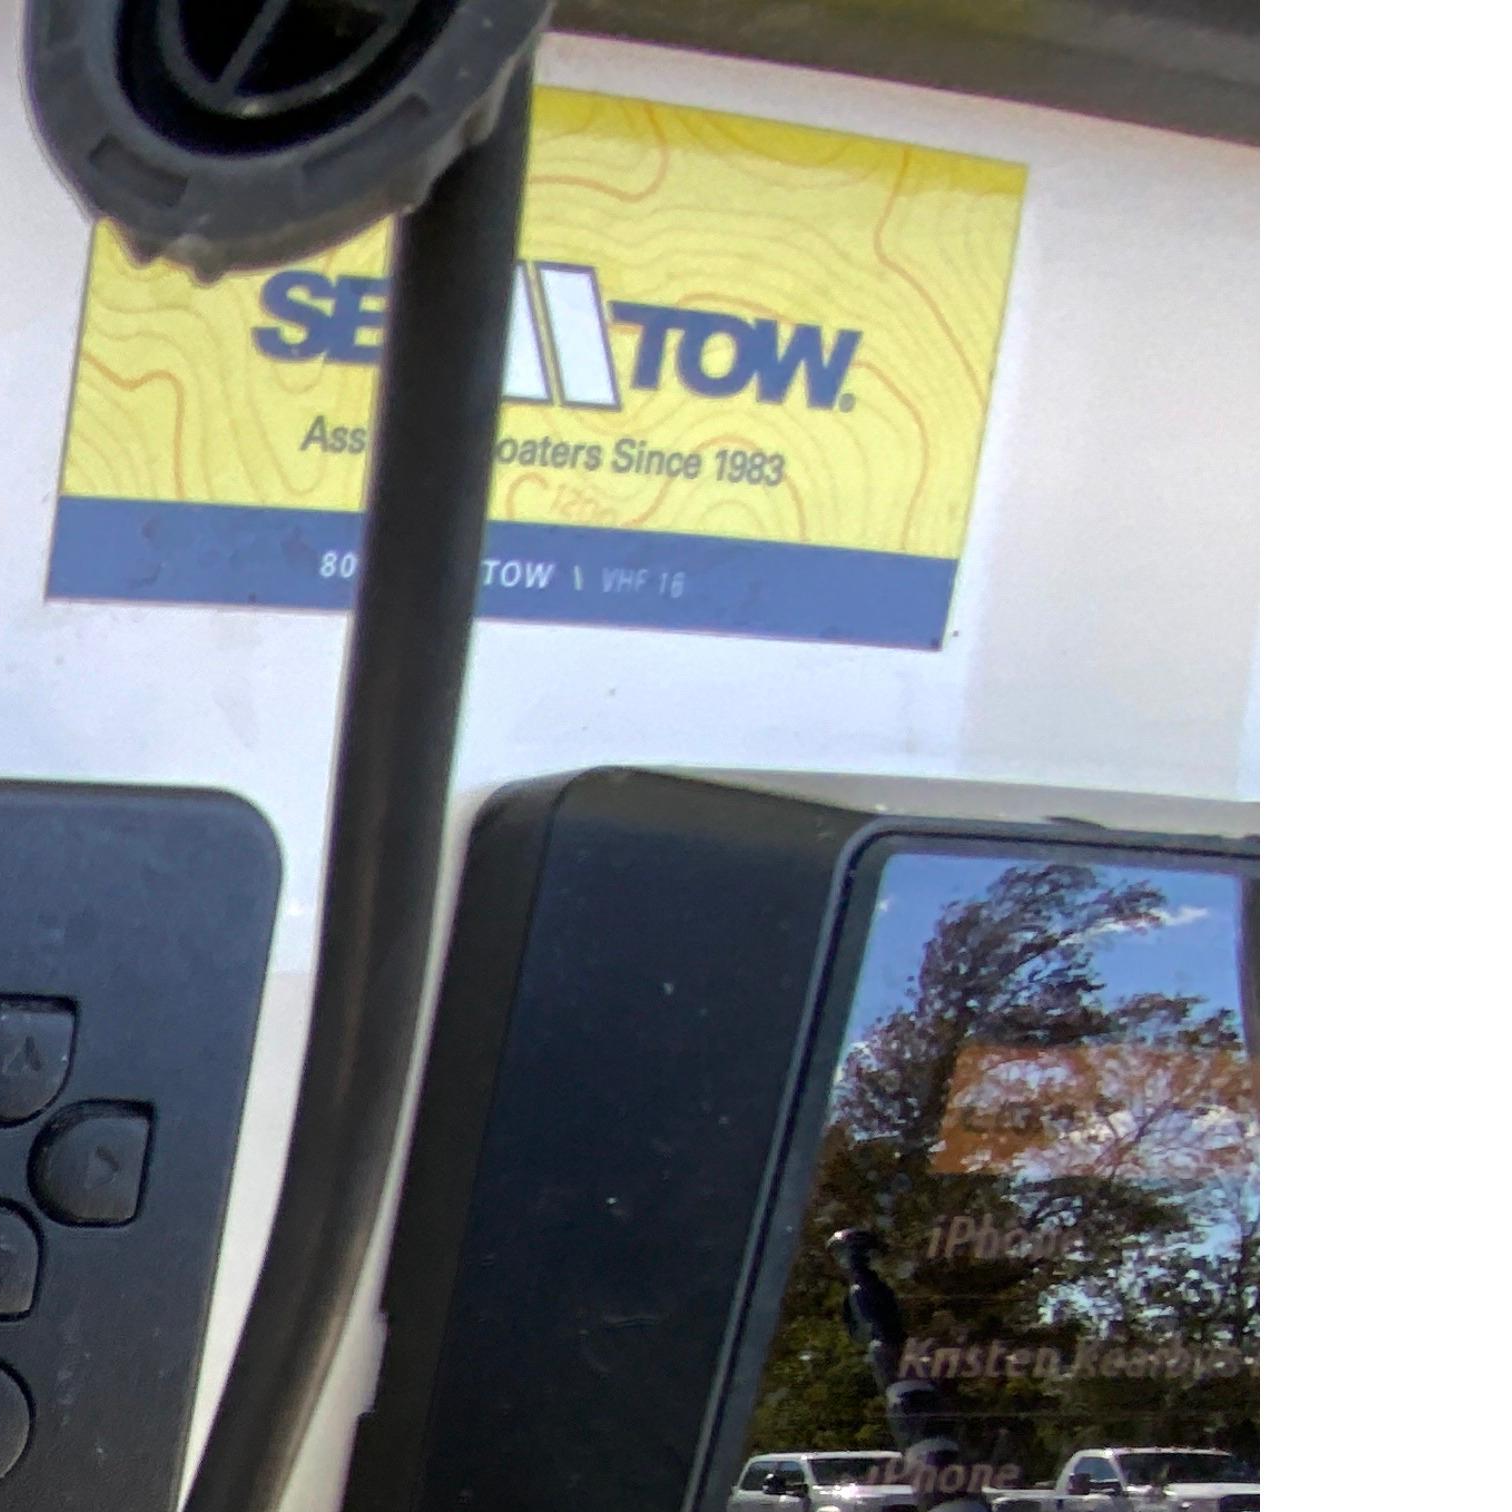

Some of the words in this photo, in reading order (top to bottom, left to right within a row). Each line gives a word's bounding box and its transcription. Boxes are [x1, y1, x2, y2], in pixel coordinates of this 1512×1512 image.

[250, 271, 390, 366] SE
[494, 436, 603, 472] oaters
[612, 438, 702, 480] Since
[714, 448, 787, 488] 1983
[600, 566, 649, 594] VHF
[868, 1455, 1022, 1495] iPhone
